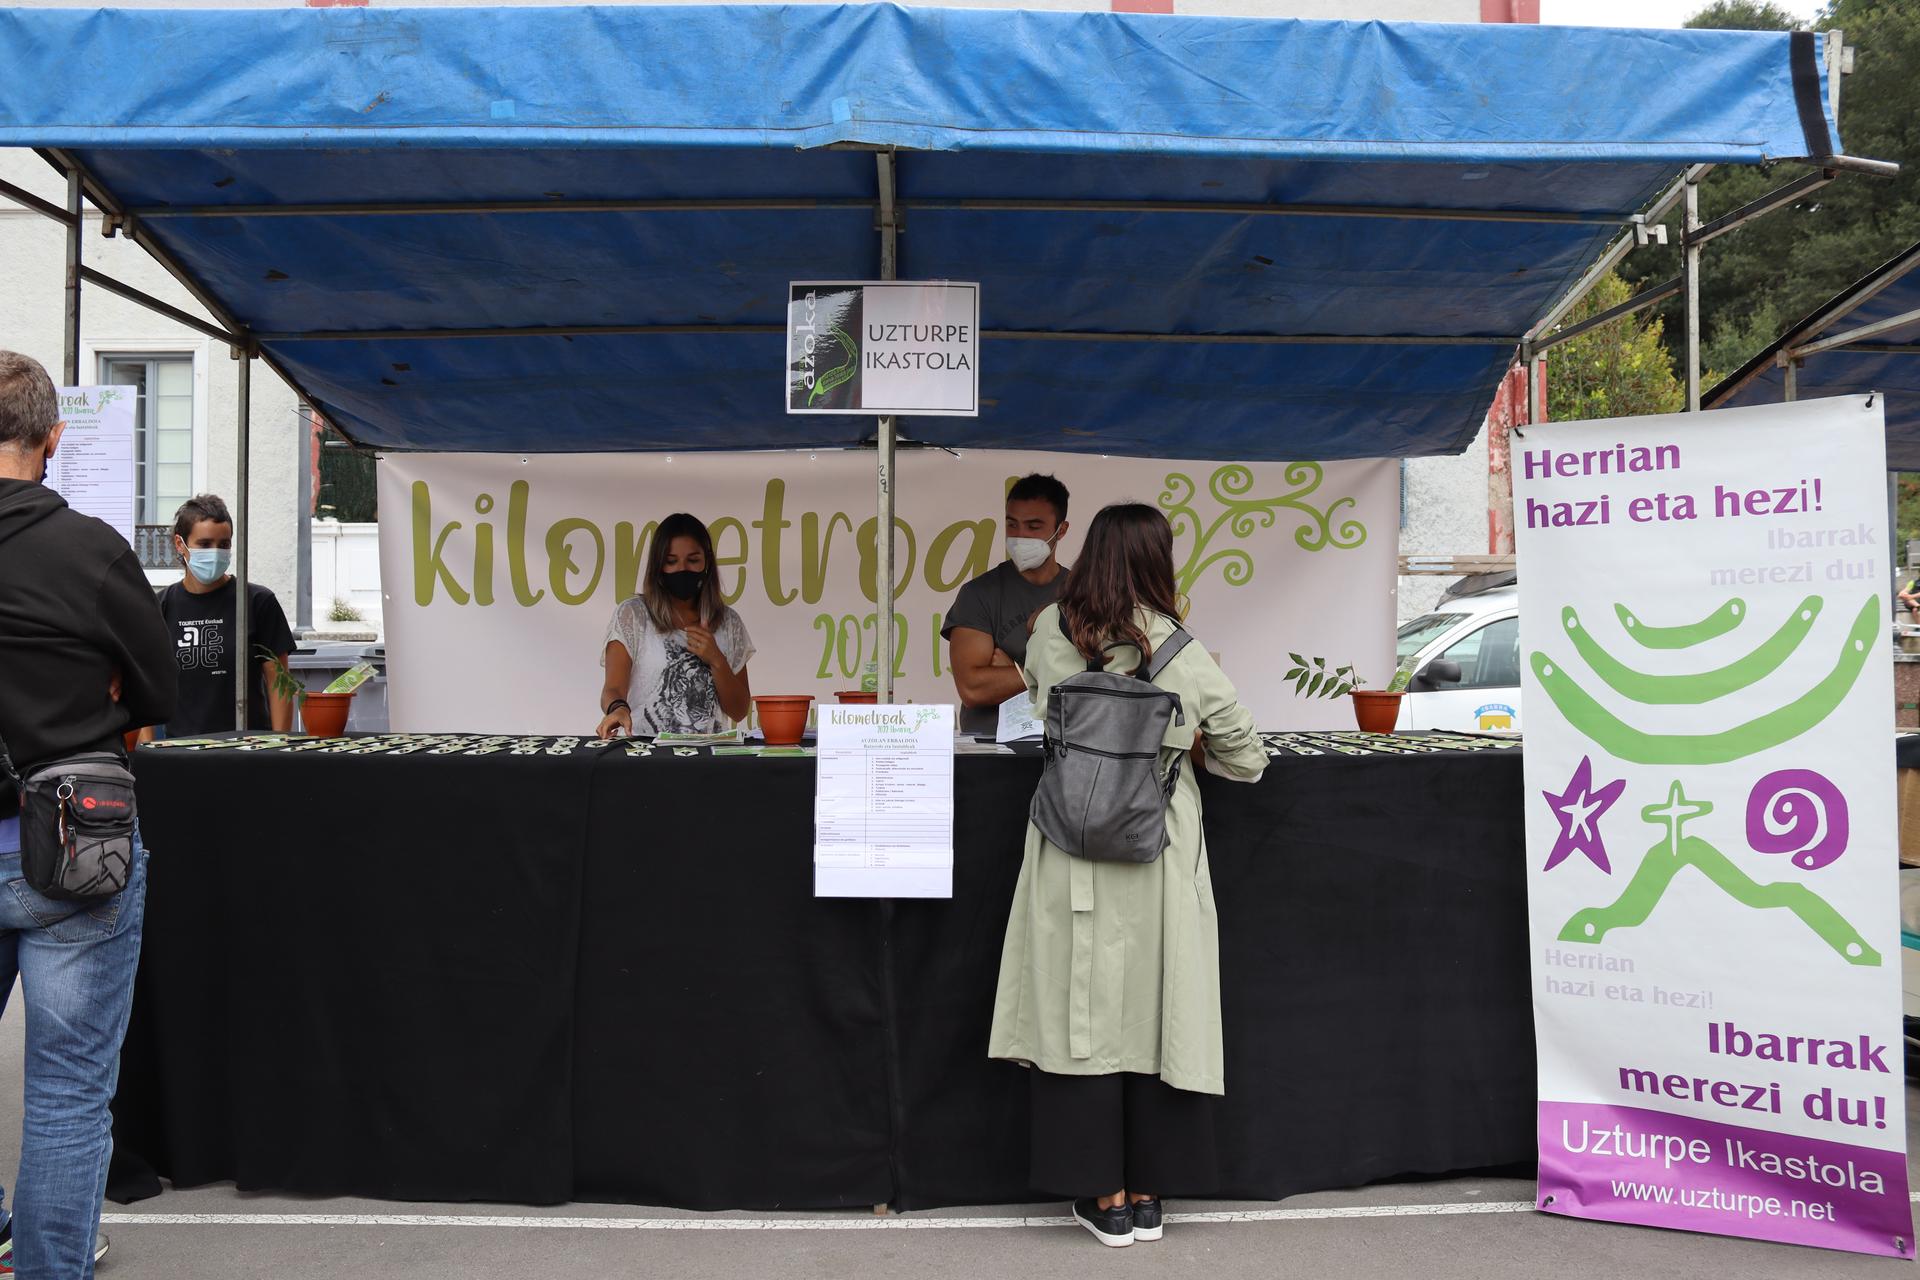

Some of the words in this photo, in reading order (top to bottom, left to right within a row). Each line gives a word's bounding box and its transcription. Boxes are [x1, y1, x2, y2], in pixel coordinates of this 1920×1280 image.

[795, 289, 816, 390] azoka
[869, 324, 969, 343] UZTURPE
[866, 352, 970, 370] IKASTOLA
[1523, 443, 1681, 480] Herrian
[1526, 494, 1610, 529] hazi
[1627, 492, 1697, 523] eta
[1714, 478, 1823, 518] hezi!
[1767, 524, 1877, 551] Ibarrak
[1710, 561, 1813, 586] merezi
[1826, 558, 1876, 583] du!
[831, 710, 906, 725] kilometroak
[1544, 948, 1635, 973] Herrian
[1546, 976, 1596, 998] hazi
[1604, 983, 1644, 1003] eta
[1653, 985, 1714, 1009] hezi!
[1708, 1022, 1891, 1073] Ibarrak
[1618, 1066, 1782, 1114] merezi
[1802, 1087, 1886, 1130] du!
[1562, 1119, 1711, 1169] Uzturpe
[1725, 1138, 1885, 1195] Ikastola
[1611, 1177, 1835, 1222] www.uzturpe.net
